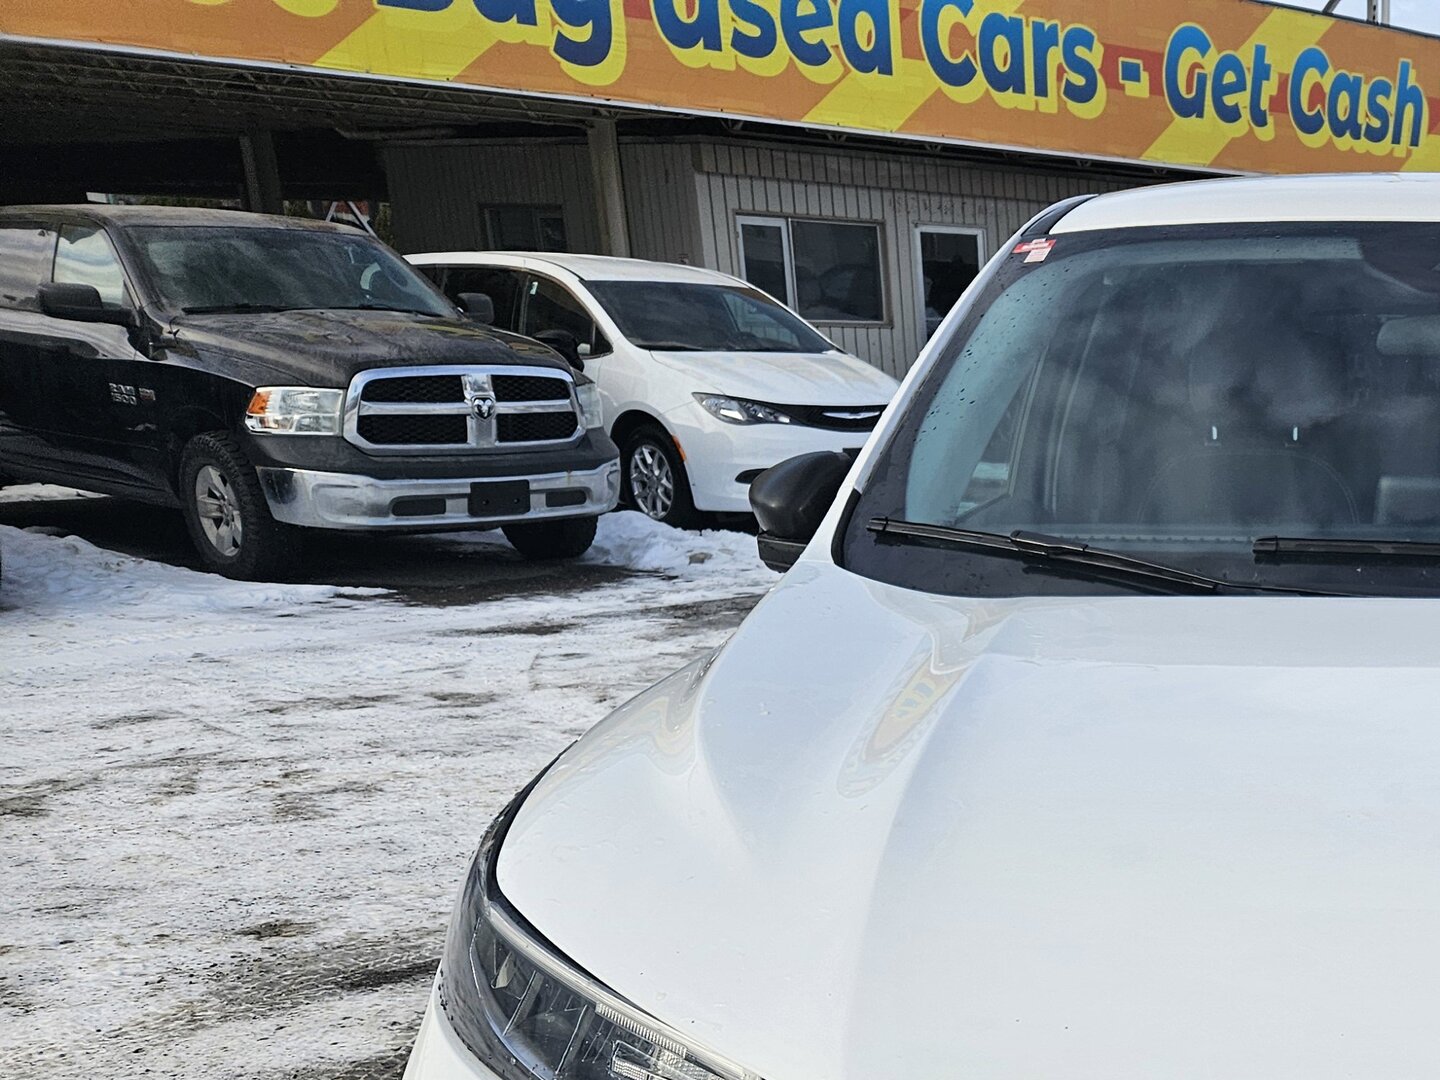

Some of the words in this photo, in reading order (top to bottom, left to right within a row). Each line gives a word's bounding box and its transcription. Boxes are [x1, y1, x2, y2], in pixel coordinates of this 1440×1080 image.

[920, 0, 1100, 104] Cars
[1164, 25, 1272, 128] Get
[1289, 47, 1424, 147] Cash
